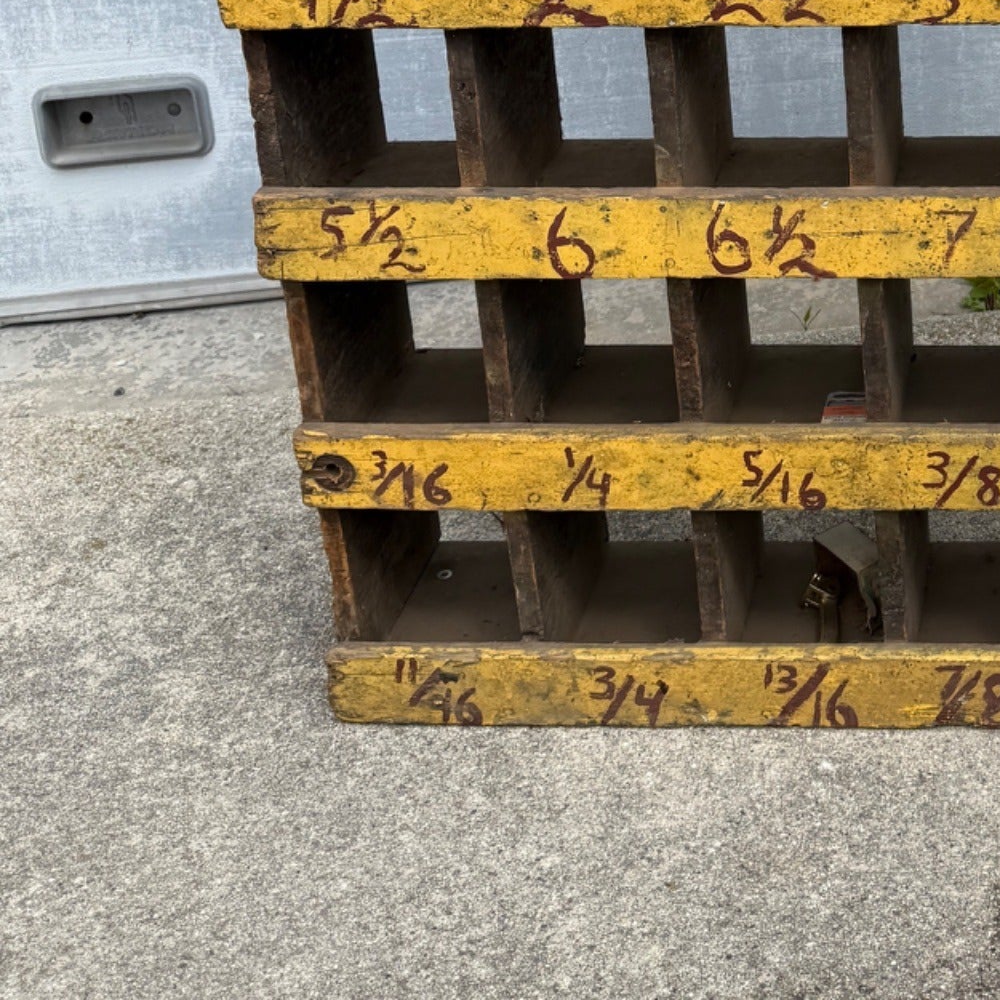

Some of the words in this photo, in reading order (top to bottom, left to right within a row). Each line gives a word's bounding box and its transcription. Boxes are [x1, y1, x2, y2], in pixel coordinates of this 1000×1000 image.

[548, 206, 596, 279] 6
[934, 207, 978, 267] 7
[371, 450, 453, 508] 3/16
[562, 447, 611, 507] 1/4
[742, 450, 827, 512] 5/16
[396, 657, 483, 727] 11/16
[588, 666, 670, 727] 3/4
[763, 662, 858, 728] 13/16
